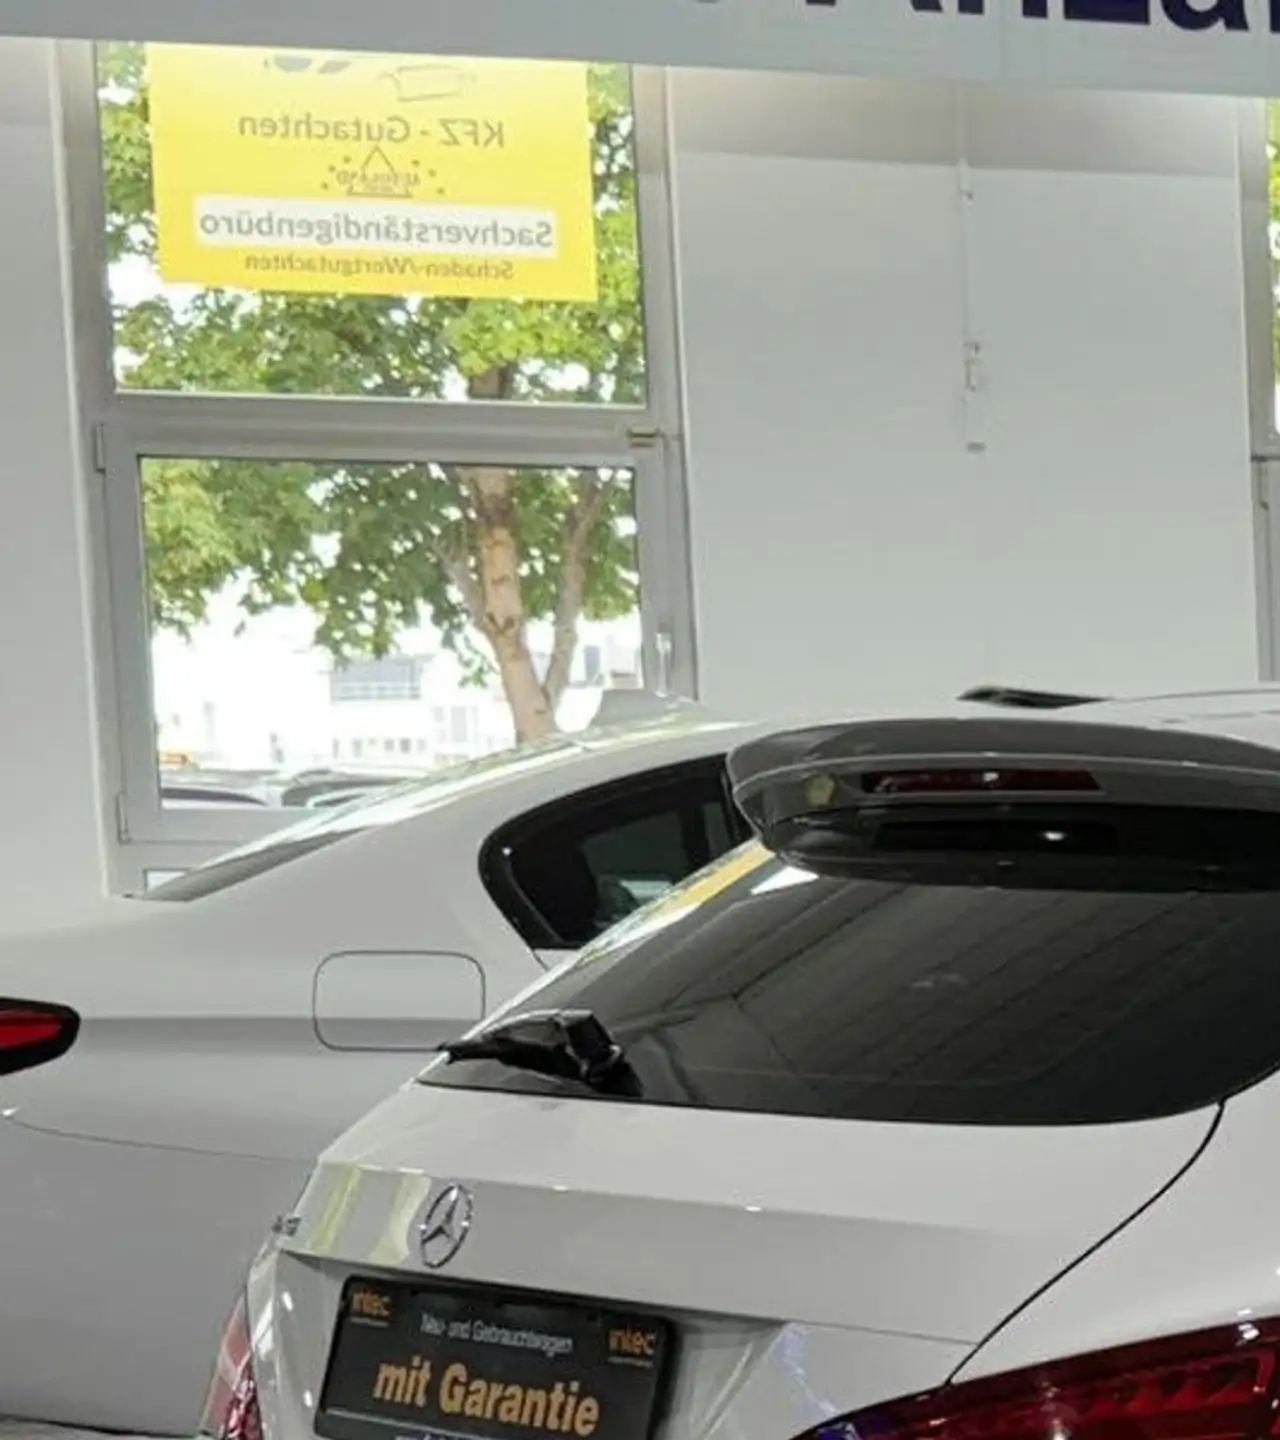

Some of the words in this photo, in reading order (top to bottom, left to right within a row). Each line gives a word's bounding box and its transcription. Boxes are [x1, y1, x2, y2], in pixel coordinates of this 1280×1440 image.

[447, 1319, 471, 1340] und
[472, 1320, 574, 1357] Gebrauchtwagen
[372, 1355, 431, 1408] mit
[439, 1362, 600, 1437] Garantie
